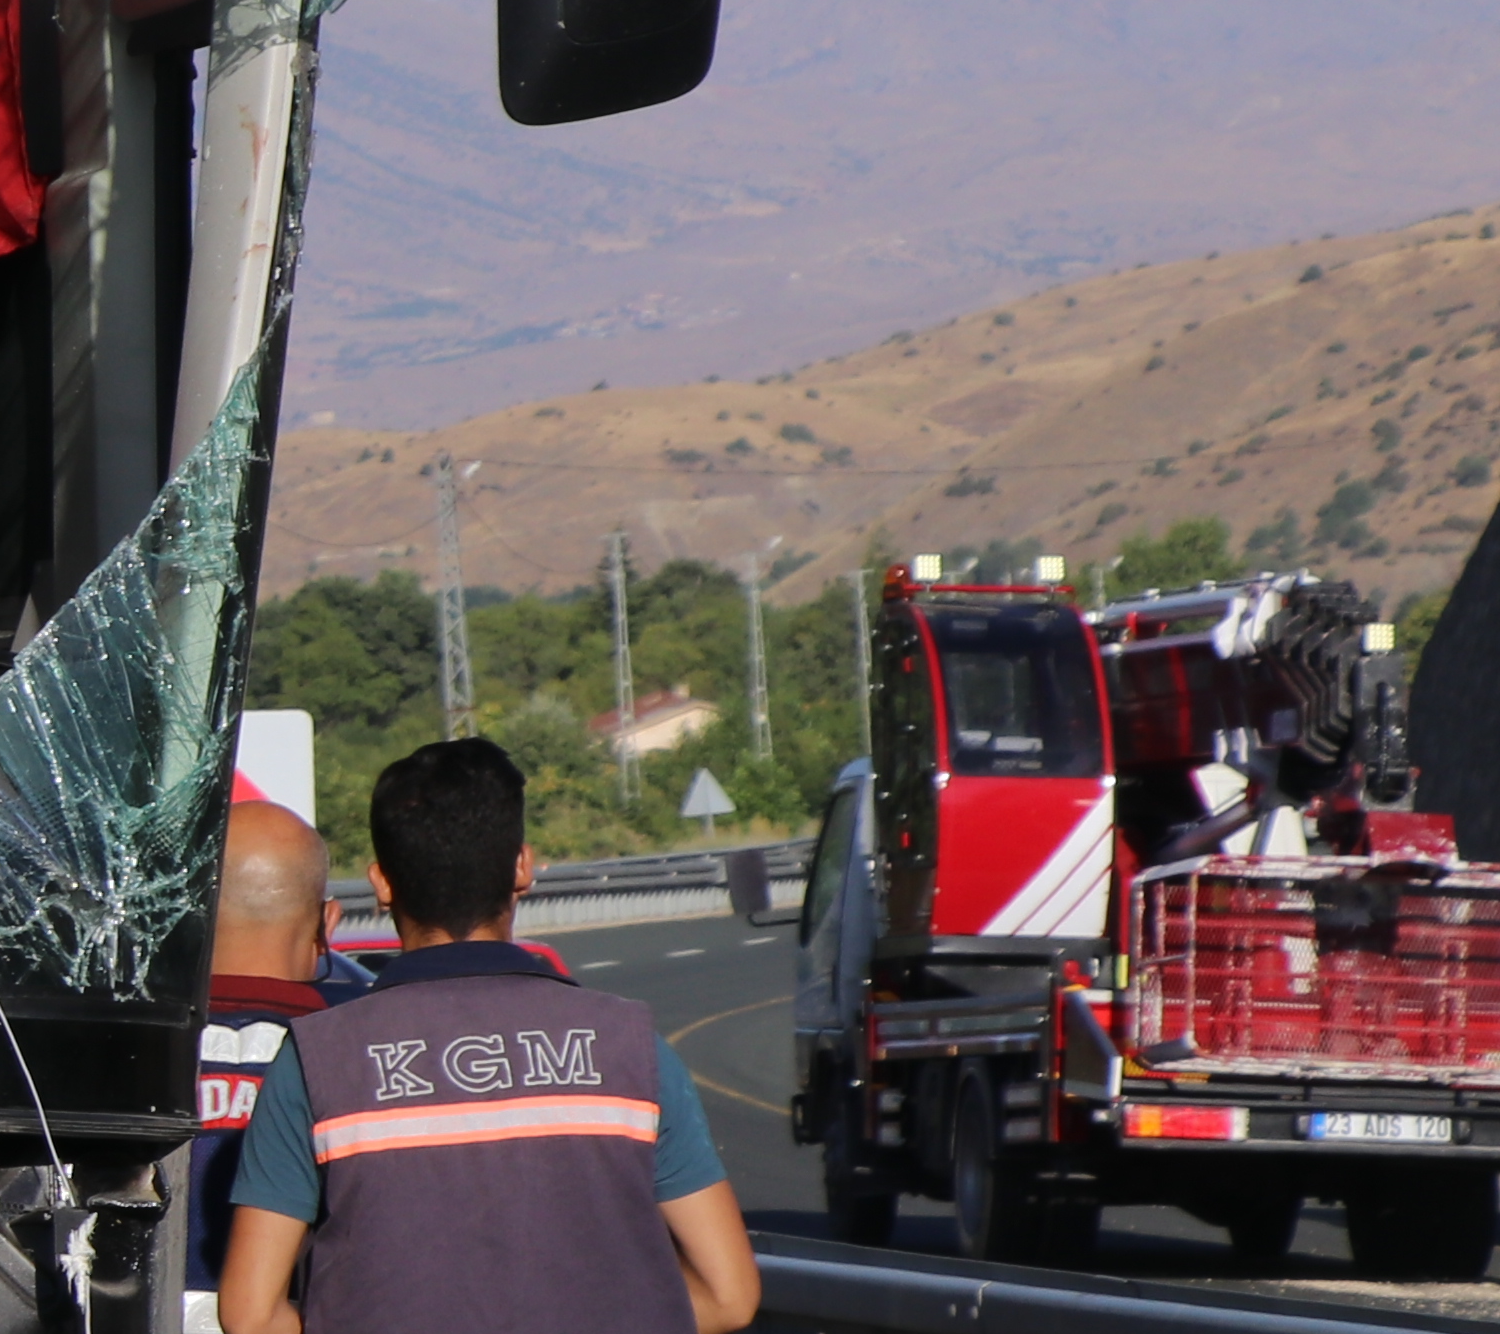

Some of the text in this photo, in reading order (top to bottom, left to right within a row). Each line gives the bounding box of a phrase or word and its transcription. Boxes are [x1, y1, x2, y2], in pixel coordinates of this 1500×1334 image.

[368, 1028, 602, 1101] KGM
[1327, 1113, 1352, 1135] 23
[1363, 1113, 1401, 1137] ADS
[1415, 1114, 1450, 1139] 120
